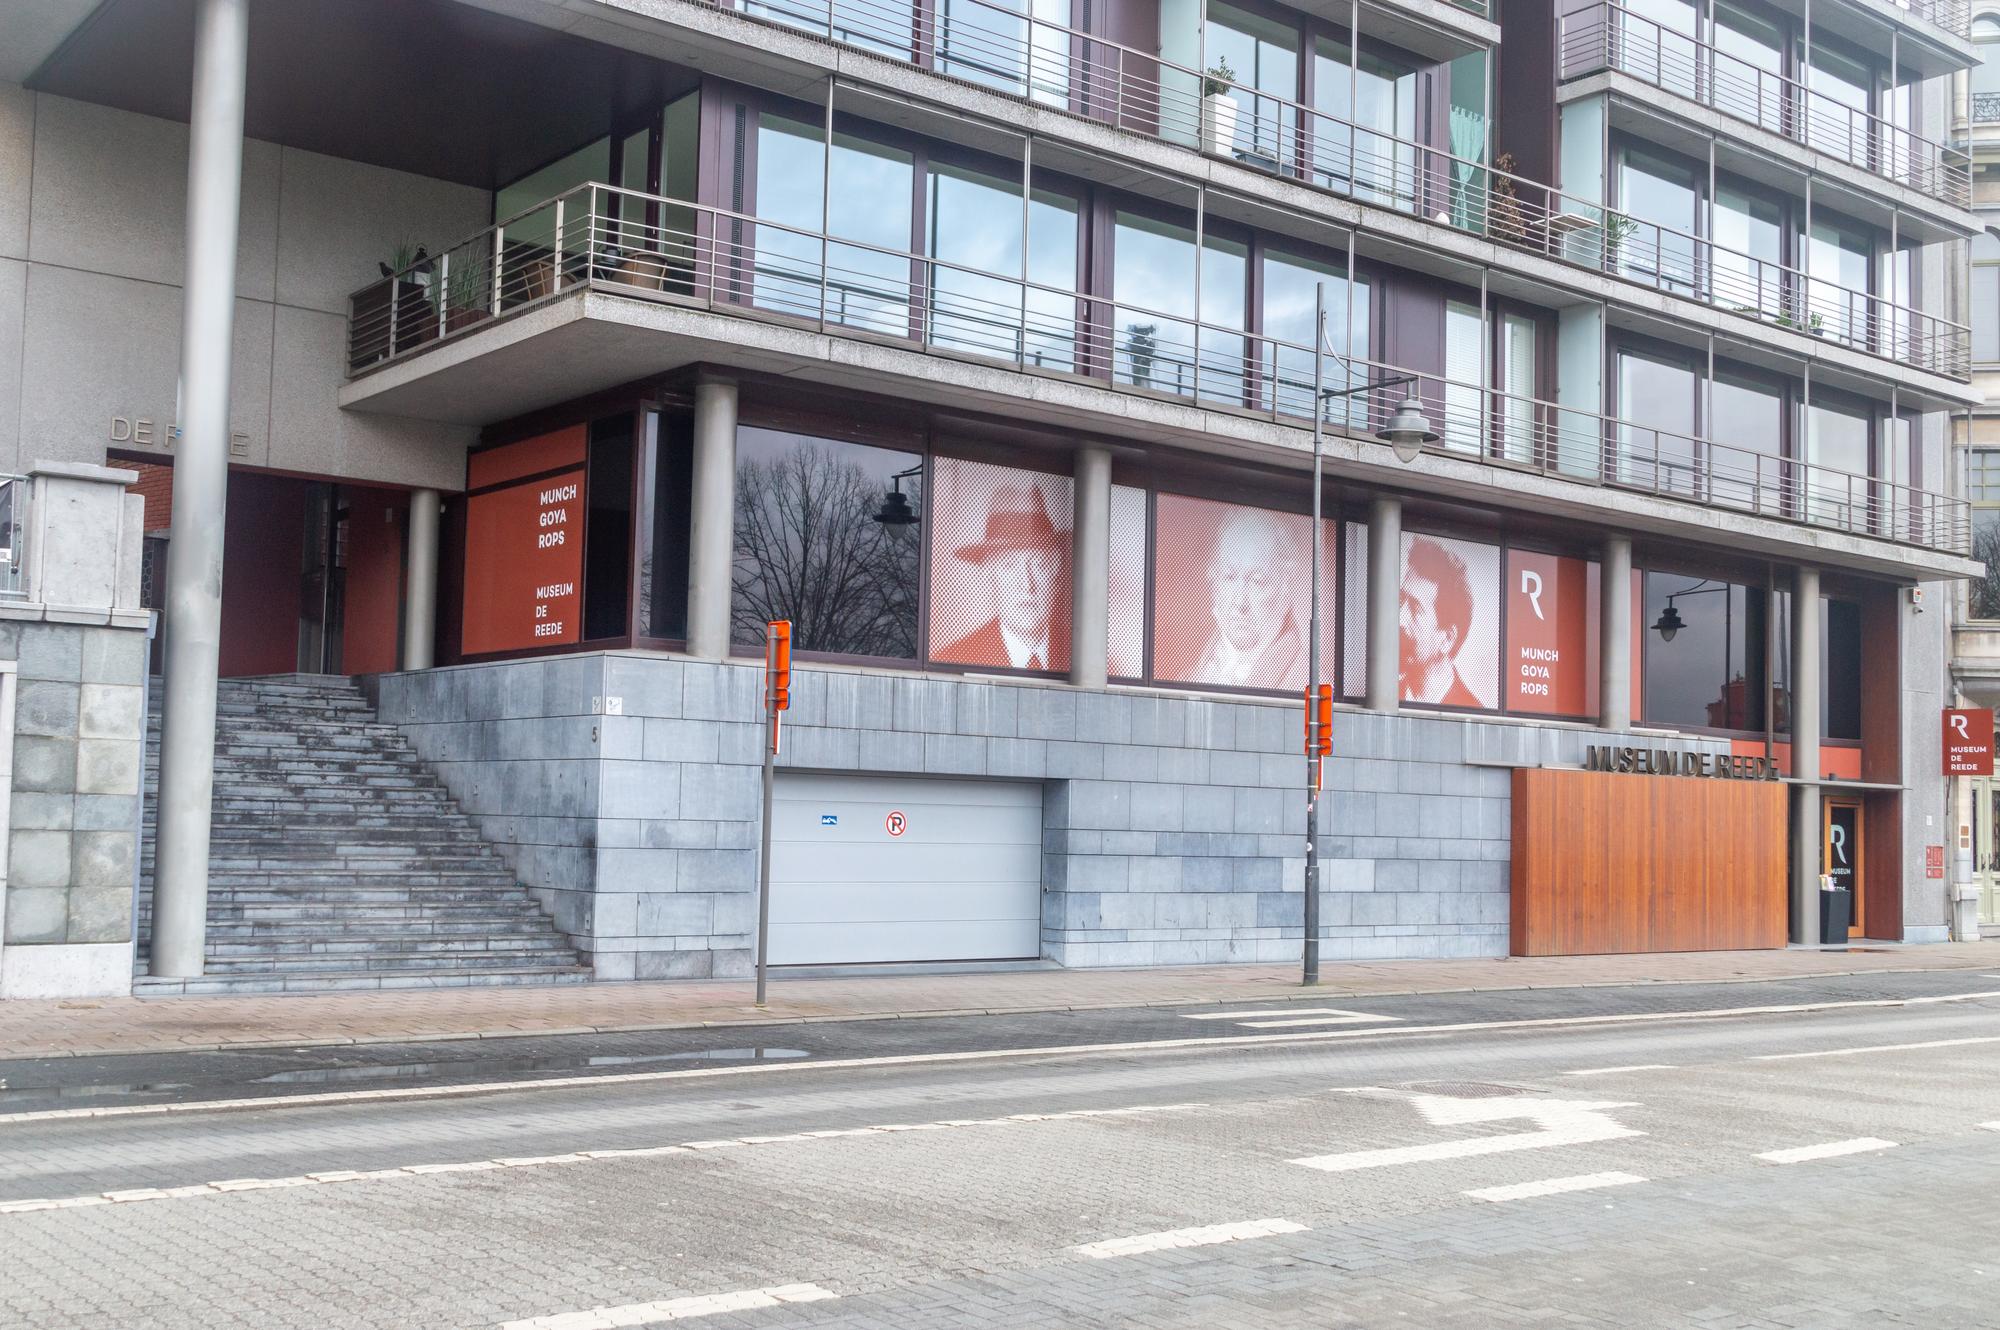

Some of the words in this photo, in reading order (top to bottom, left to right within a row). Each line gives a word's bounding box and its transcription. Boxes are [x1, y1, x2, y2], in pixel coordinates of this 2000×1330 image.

[111, 416, 153, 445] DE
[540, 484, 577, 505] MUNCH
[539, 508, 567, 527] GOYA
[538, 530, 565, 548] ROPS
[536, 582, 573, 599] MUSEUM
[535, 605, 547, 618] DE
[535, 622, 563, 637] REEDE
[1521, 647, 1559, 661] MUNCH
[1521, 664, 1550, 678] GOYA
[1521, 682, 1549, 696] ROPS
[592, 726, 598, 743] 5
[1586, 744, 1677, 776] MUSEUM
[1681, 751, 1712, 778] DE
[1714, 753, 1780, 782] REEDE
[1950, 763, 1978, 771] REEDE
